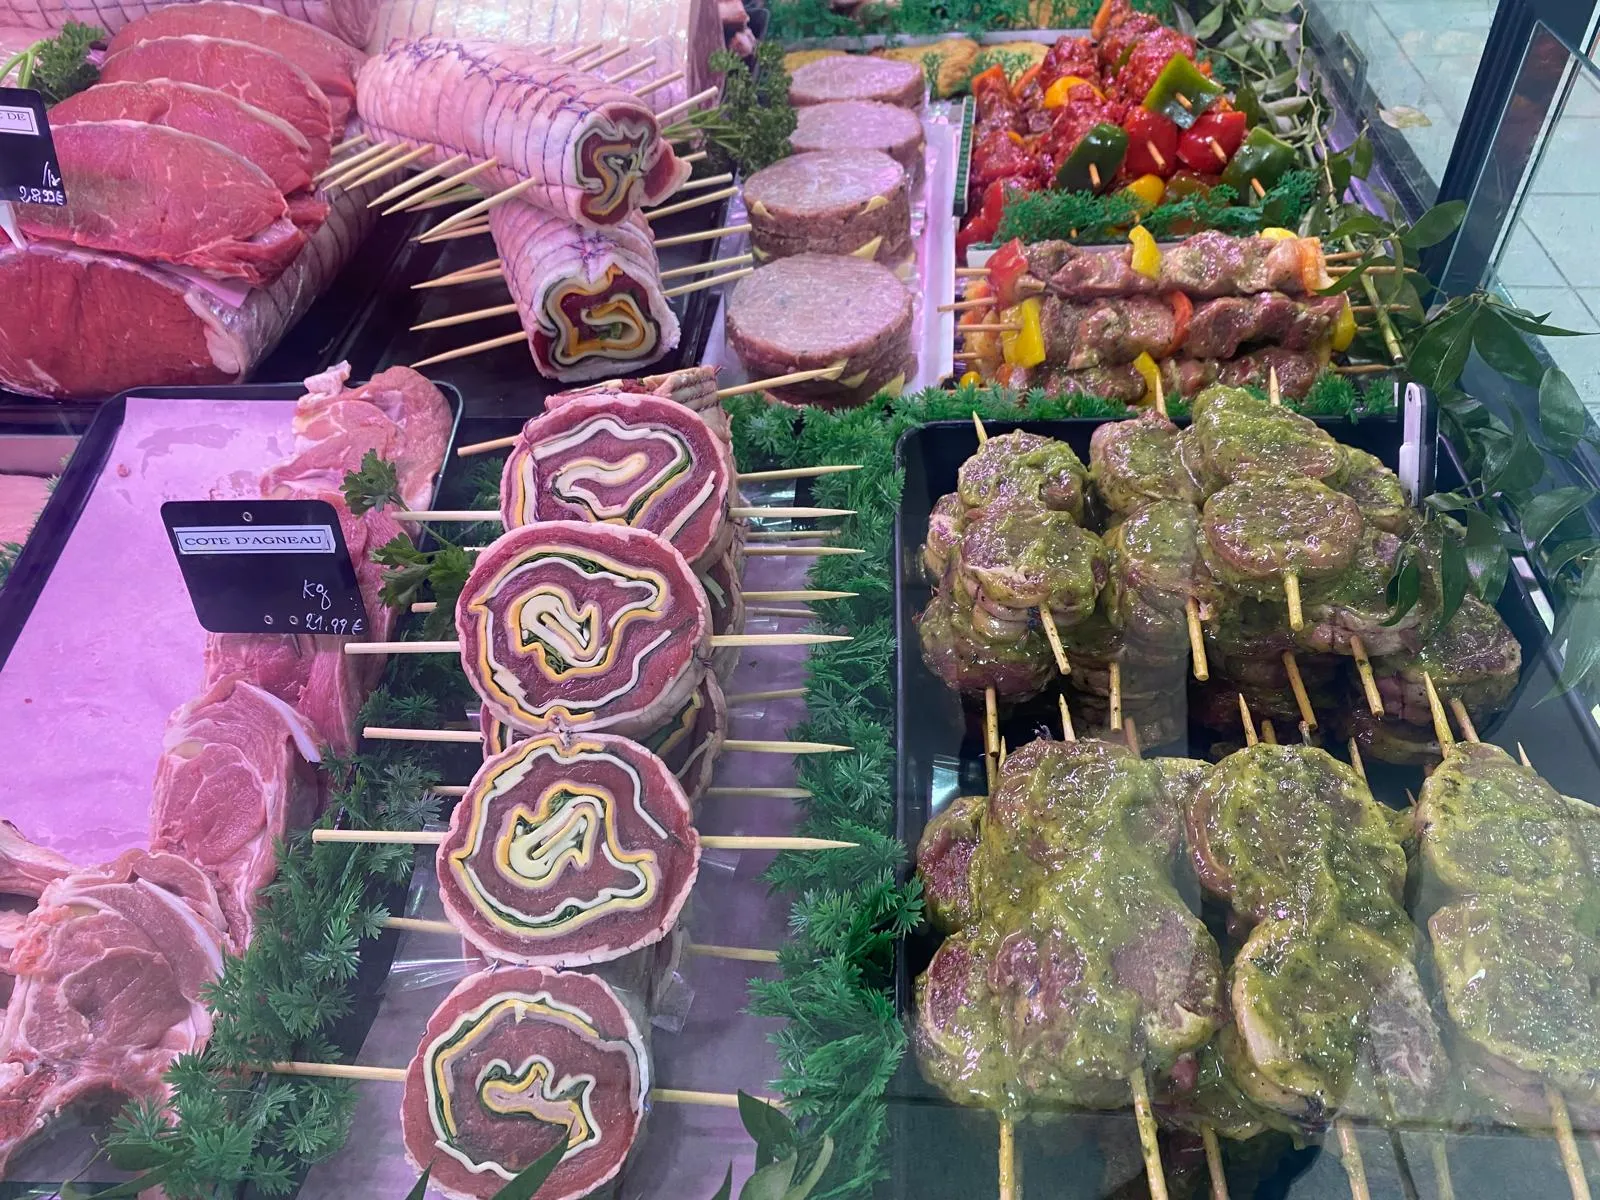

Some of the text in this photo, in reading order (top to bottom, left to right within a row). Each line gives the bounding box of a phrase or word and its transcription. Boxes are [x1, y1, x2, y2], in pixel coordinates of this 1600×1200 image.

[7, 112, 27, 121] DE
[184, 535, 322, 546] COTE D'AGNEAU
